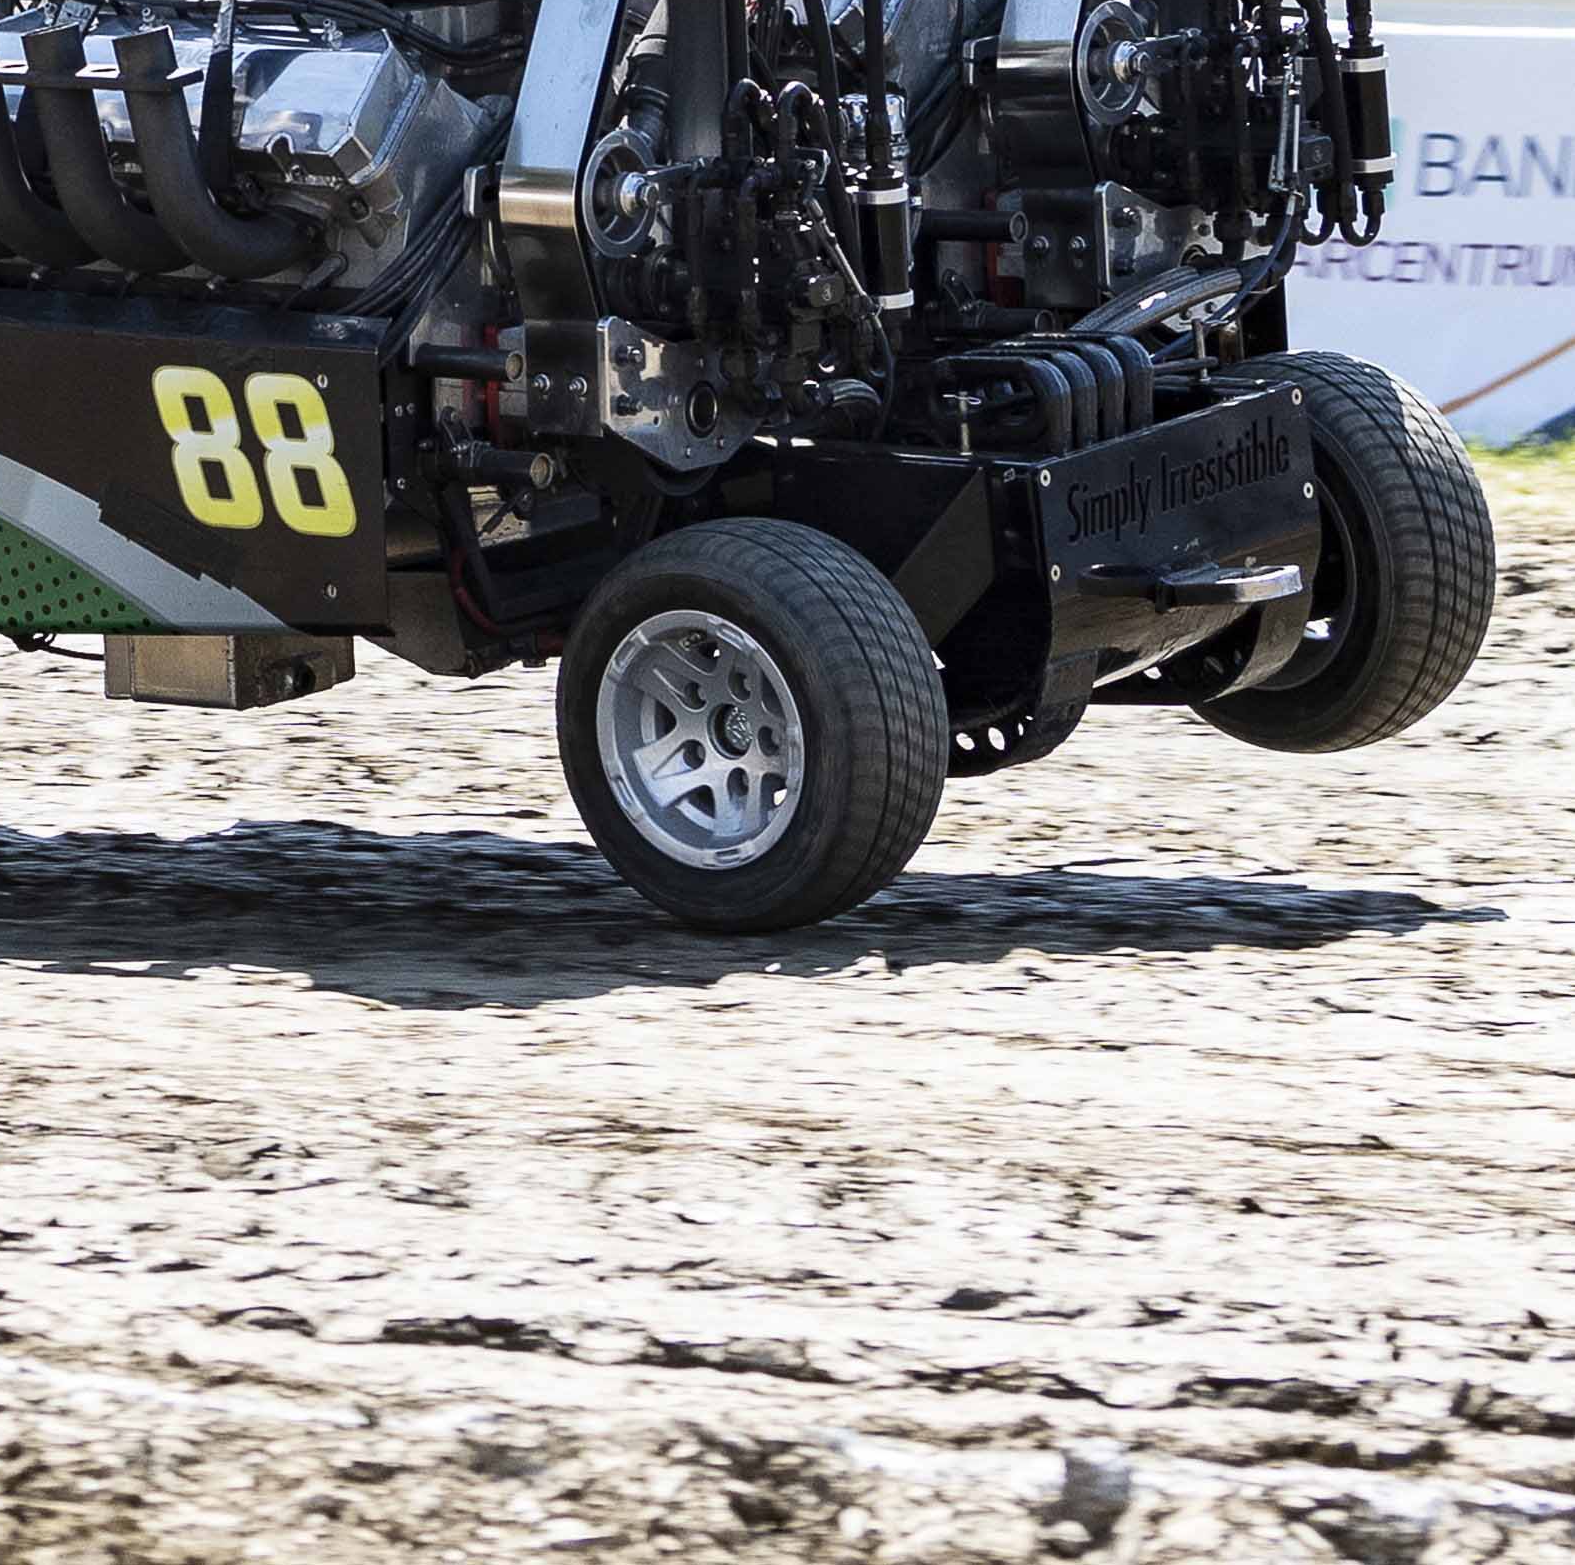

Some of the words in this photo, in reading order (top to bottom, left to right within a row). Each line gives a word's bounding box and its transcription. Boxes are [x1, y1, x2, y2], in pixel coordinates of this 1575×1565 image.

[151, 364, 357, 537] 88
[1066, 460, 1151, 544] Simply
[1160, 415, 1290, 512] Irresistible
